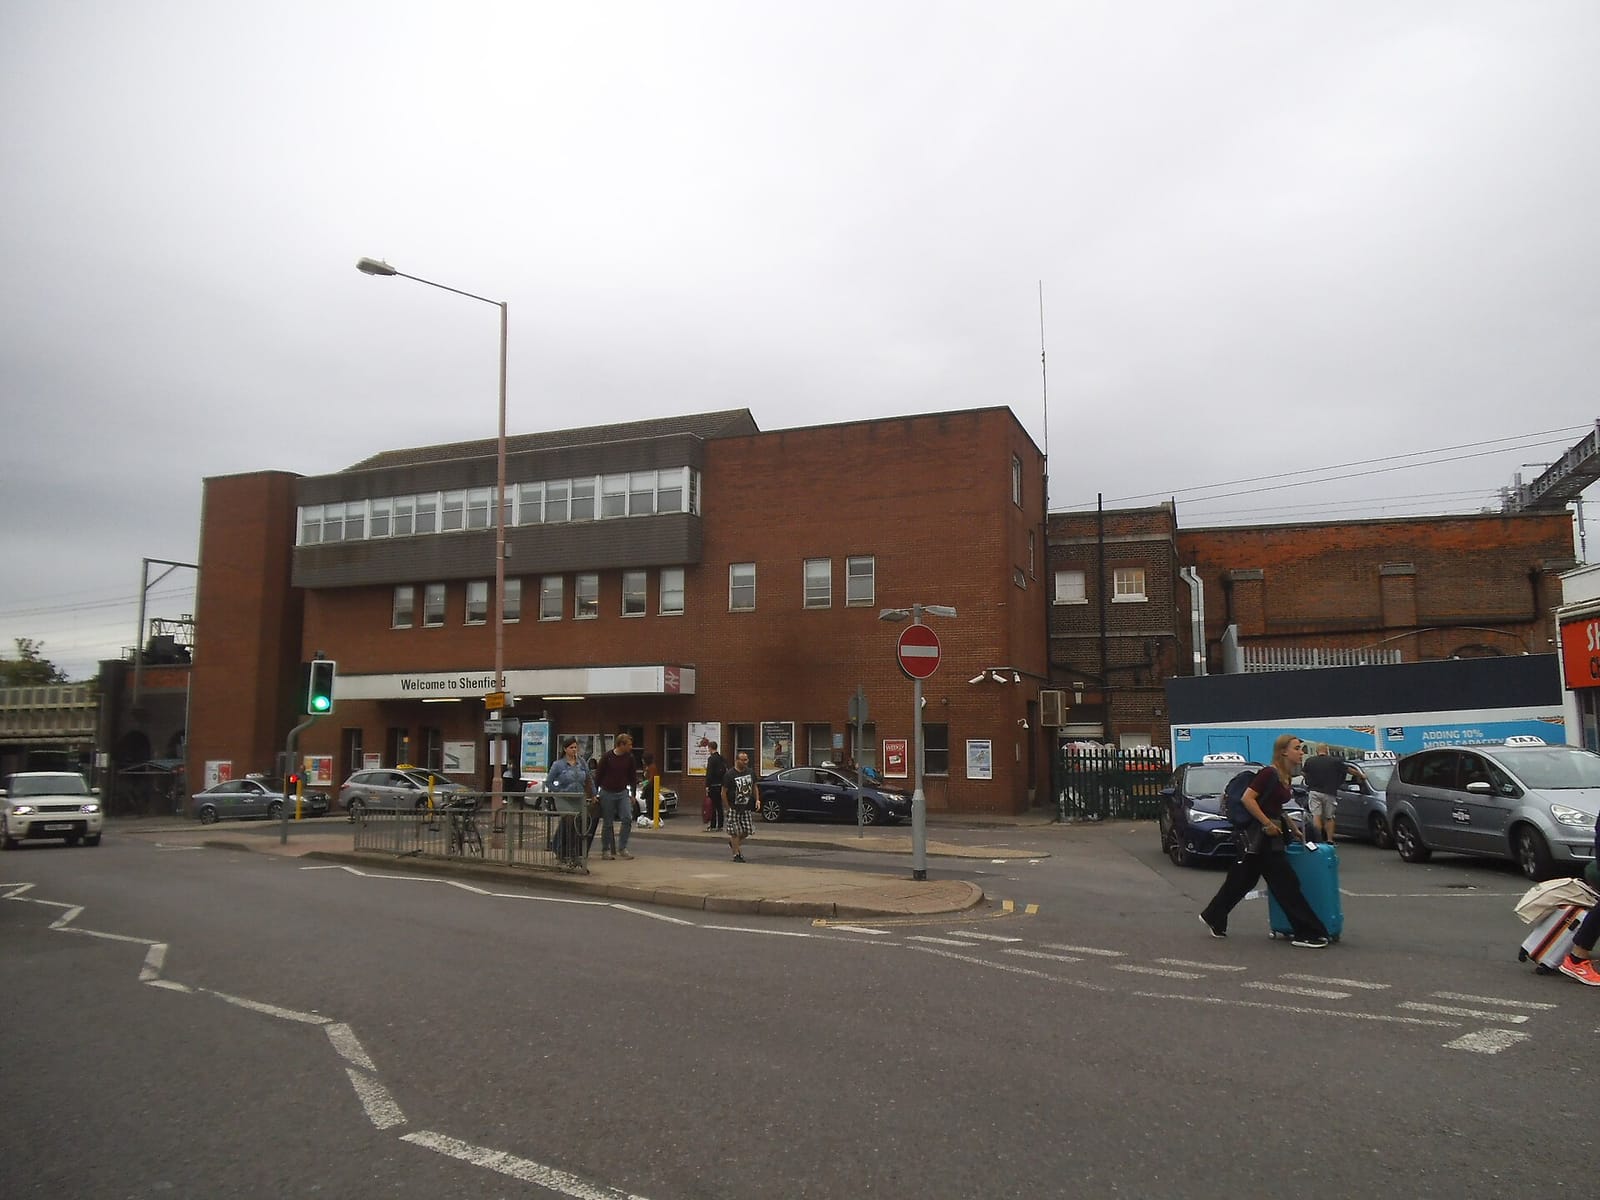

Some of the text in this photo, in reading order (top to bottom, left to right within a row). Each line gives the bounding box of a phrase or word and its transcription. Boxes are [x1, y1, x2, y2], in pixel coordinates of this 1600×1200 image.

[401, 676, 506, 690] Welcome to Shenfied
[1422, 729, 1484, 740] ADDING 10%
